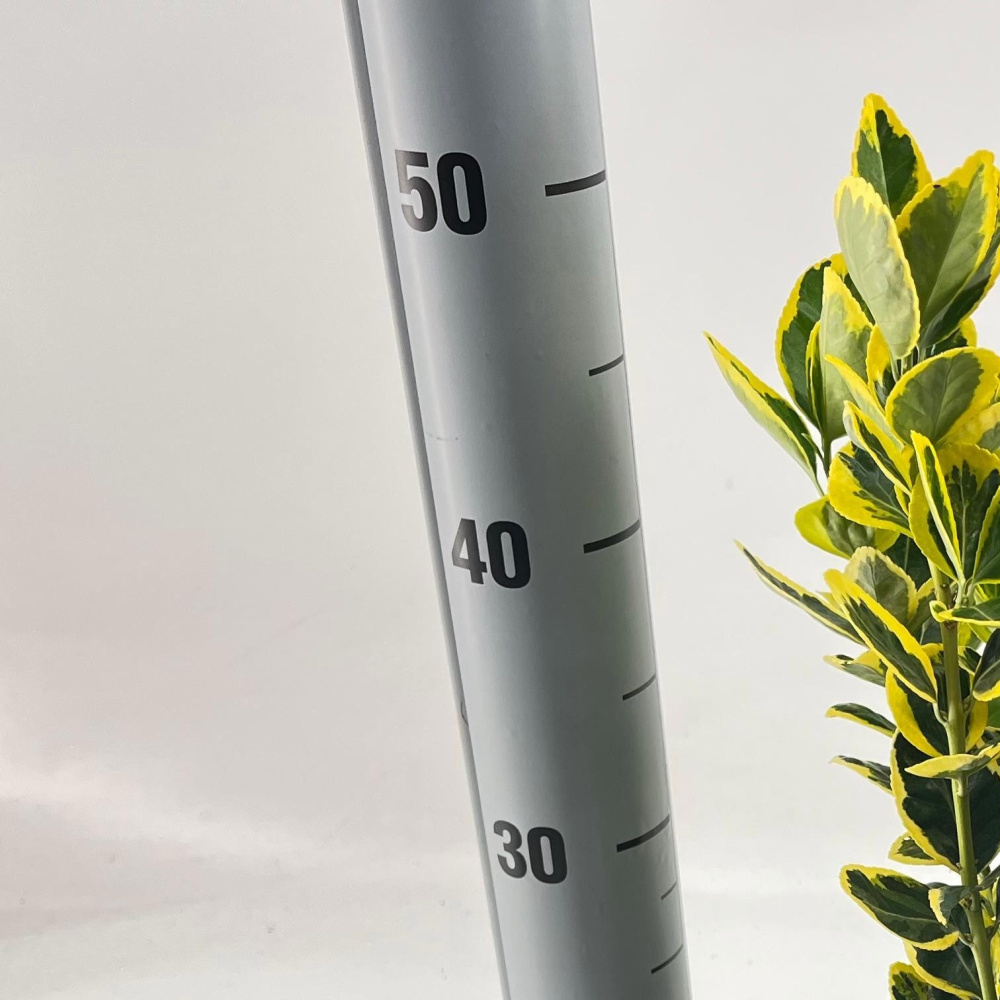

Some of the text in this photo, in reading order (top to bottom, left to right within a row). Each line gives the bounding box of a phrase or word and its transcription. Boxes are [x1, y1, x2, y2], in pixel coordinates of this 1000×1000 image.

[395, 149, 488, 236] 50
[452, 518, 531, 589] 40
[493, 820, 568, 884] 30
